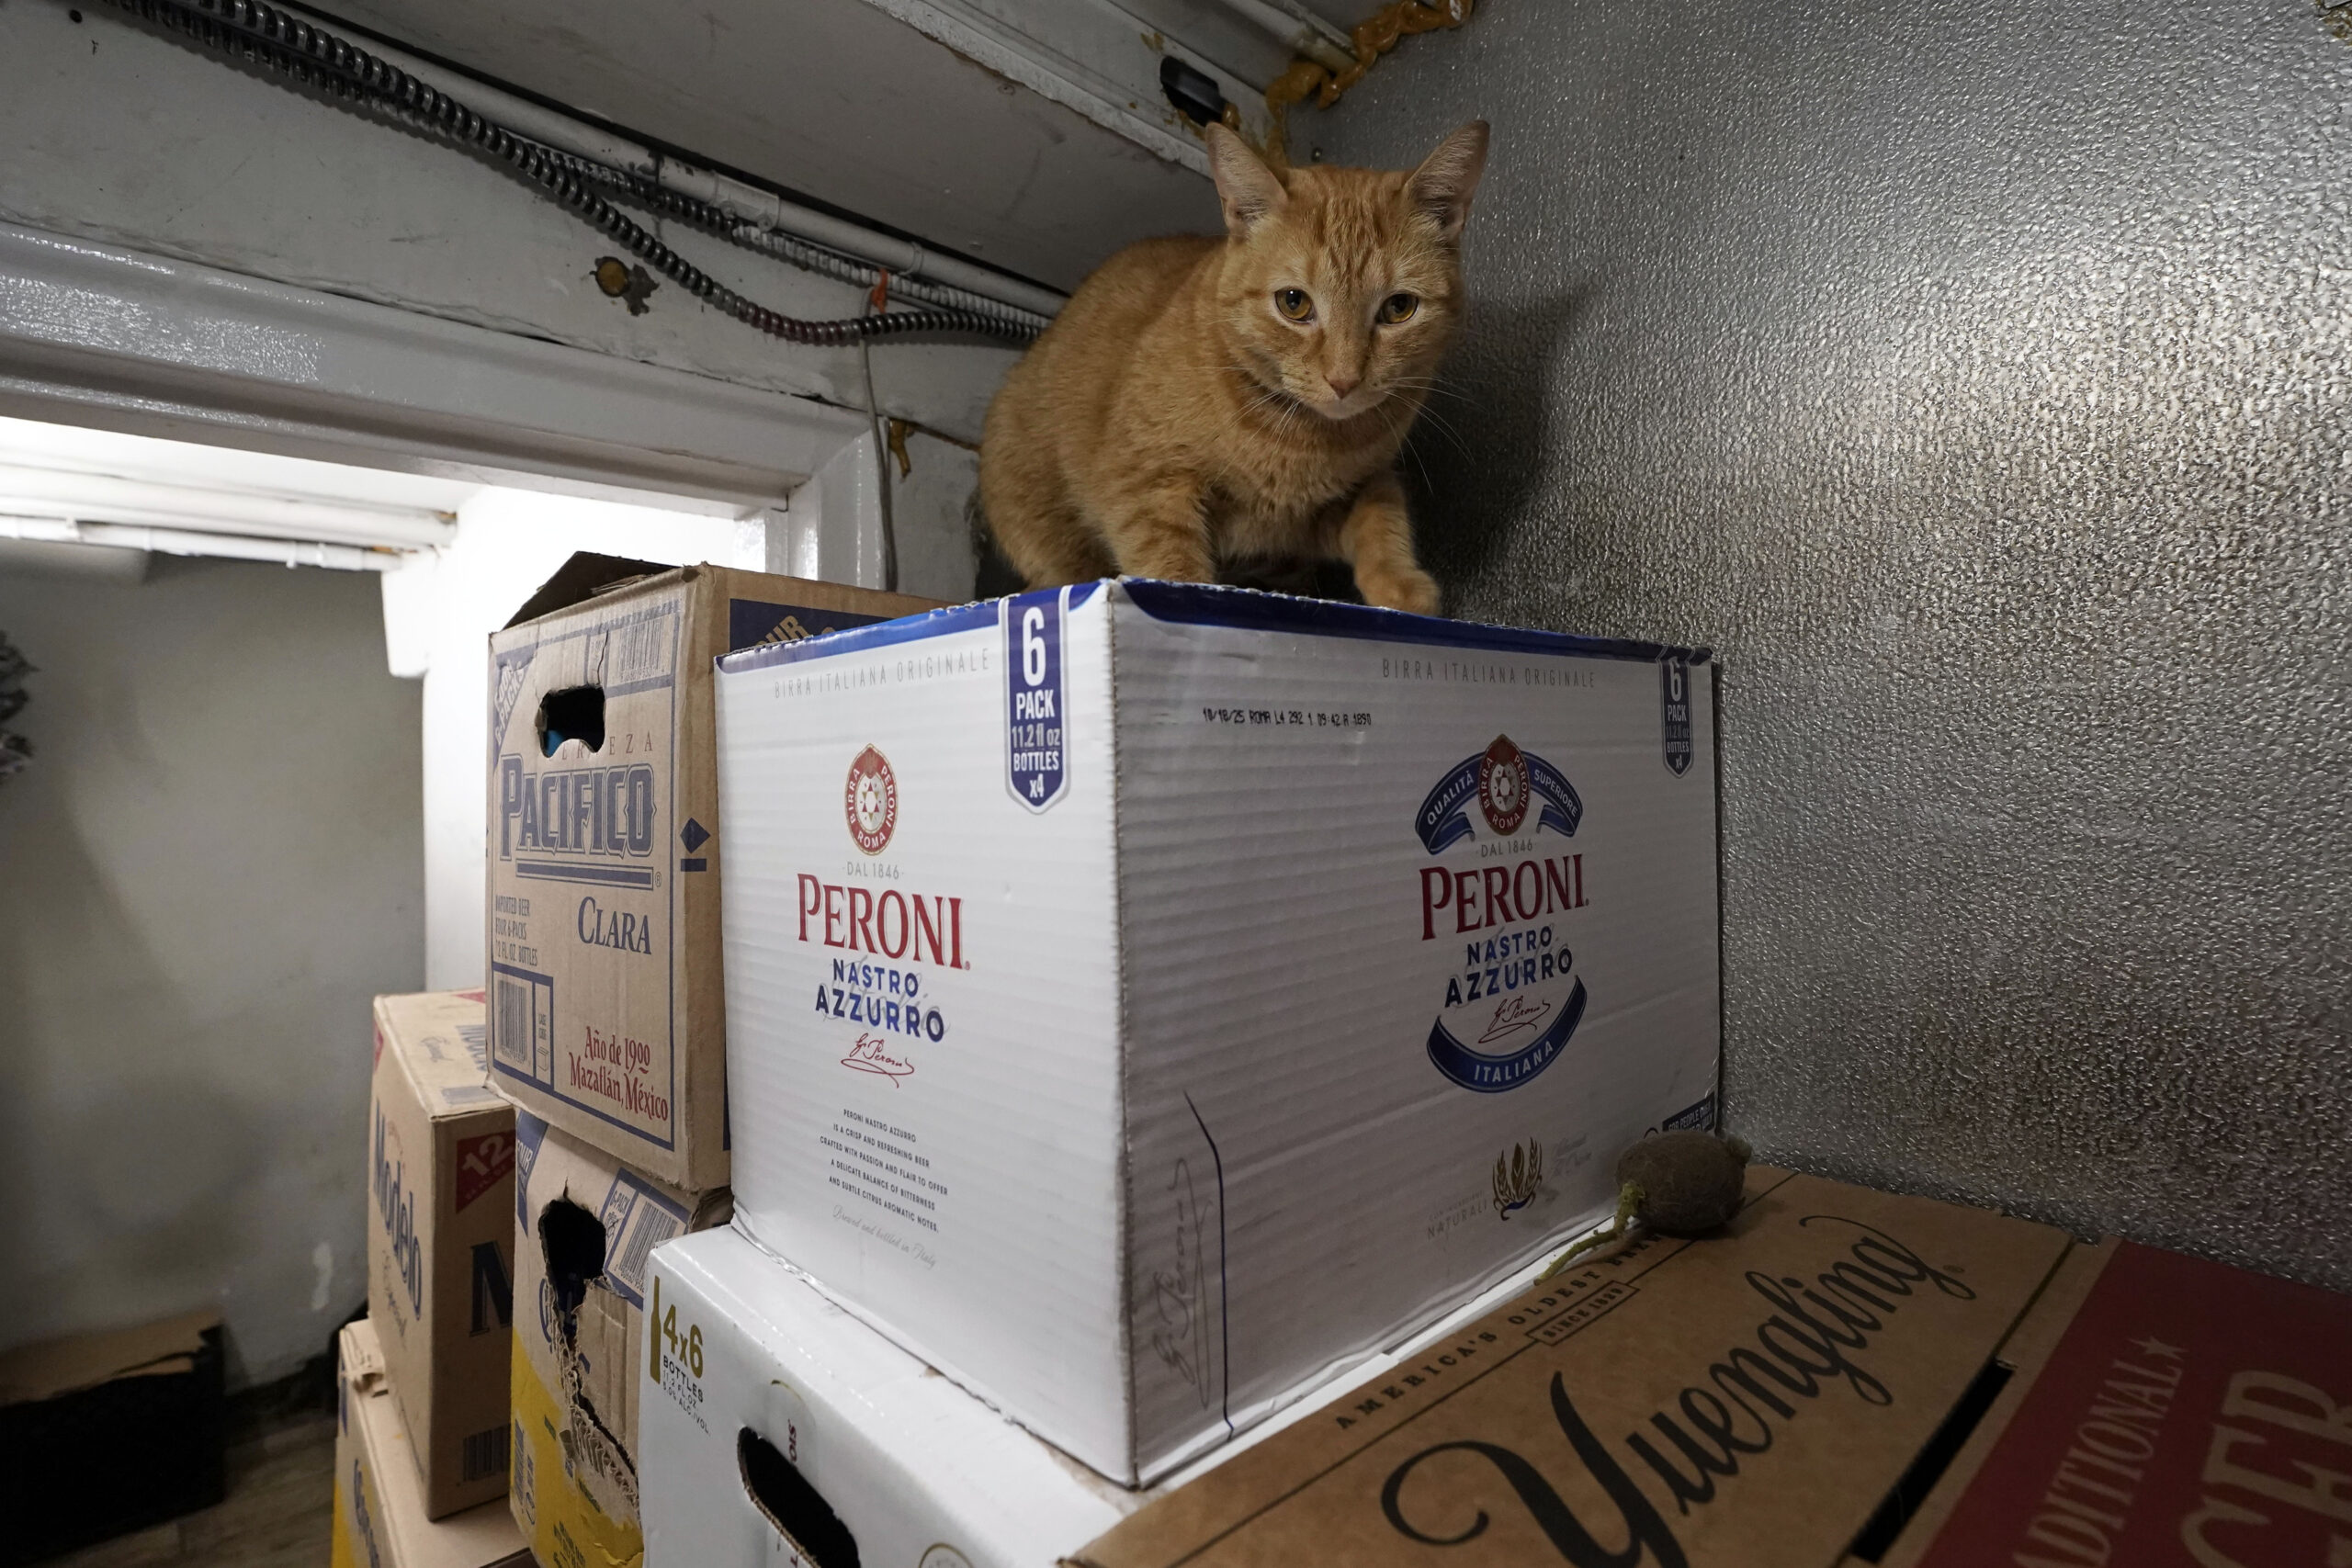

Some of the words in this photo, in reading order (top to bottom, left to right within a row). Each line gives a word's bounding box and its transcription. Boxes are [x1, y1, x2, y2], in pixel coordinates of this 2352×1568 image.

[1022, 606, 1046, 686] 6
[774, 676, 812, 699] BIRRA
[820, 664, 888, 693] ITALIANA
[897, 647, 991, 682] ORIGINALE
[1382, 658, 1435, 680] BIRRA
[1443, 661, 1516, 684] ITALIANA
[1524, 667, 1596, 689] ORIGINALE
[1668, 656, 1682, 702] 6
[1015, 689, 1055, 720] PACK
[1288, 710, 1304, 726] 292
[1668, 705, 1687, 722] PACK
[1011, 725, 1035, 750] 11.2
[1046, 727, 1061, 748] oz
[1012, 750, 1059, 773] BOTTLES
[1667, 740, 1690, 753] BOTTLES
[846, 766, 861, 825] BIRRA
[879, 765, 896, 828] PERONI
[1029, 773, 1045, 798] x4
[1427, 771, 1475, 826] QUALITÀ
[1482, 757, 1493, 809] BIRRA
[1513, 754, 1528, 808] PERONI
[1533, 768, 1577, 818] SUPERIORE
[500, 753, 657, 861] PACIFICO
[1492, 813, 1521, 829] ROMA
[857, 830, 886, 849] ROMA
[1481, 842, 1504, 858] DAL
[1508, 839, 1533, 855] 1846
[847, 862, 868, 878] DAL
[874, 863, 899, 880] 1846
[1419, 853, 1584, 941] PERONI
[577, 896, 652, 956] CLARA
[797, 874, 964, 970] PERONI
[1466, 925, 1553, 966] NASTRO
[832, 957, 919, 998] NASTRO
[1444, 947, 1573, 1008] AZZURRO
[816, 985, 944, 1043] AZZURRO
[608, 1035, 622, 1064] de
[1474, 1041, 1553, 1083] ITALIANA
[625, 1069, 669, 1122] México
[833, 1123, 839, 1133] IS
[840, 1125, 844, 1134] A
[845, 1128, 862, 1142] CRISP
[863, 1135, 876, 1146] AND
[876, 1141, 912, 1161] REFRESHING
[914, 1154, 930, 1168] BEER
[843, 1109, 864, 1122] PERONI
[865, 1116, 888, 1133] NASTRO
[889, 1125, 917, 1143] AZZURRO
[820, 1135, 843, 1151] CRAFTED
[844, 1145, 858, 1157] WITH
[859, 1152, 884, 1168] PASSION
[885, 1163, 898, 1174] AND
[899, 1168, 917, 1182] FLAIR
[918, 1176, 926, 1187] TO
[928, 1181, 948, 1195] OFFER
[836, 1160, 861, 1178] DELICATE
[863, 1172, 888, 1190] BALANCE
[890, 1184, 899, 1194] OF
[900, 1188, 935, 1211] BITTERNESS
[829, 1176, 841, 1187] AND
[842, 1181, 861, 1196] SUBTLE
[862, 1190, 882, 1206] CITRUS
[884, 1201, 915, 1222] AROMATIC
[917, 1215, 939, 1233] NOTES.
[663, 1303, 704, 1379] 4x6
[1544, 1309, 1589, 1338] SINCE
[1335, 1326, 1500, 1431] AMERICA'S
[1509, 1269, 1601, 1325] OLDEST
[663, 1355, 704, 1404] BOTTLES
[1381, 1214, 1976, 1568] Yuengling
